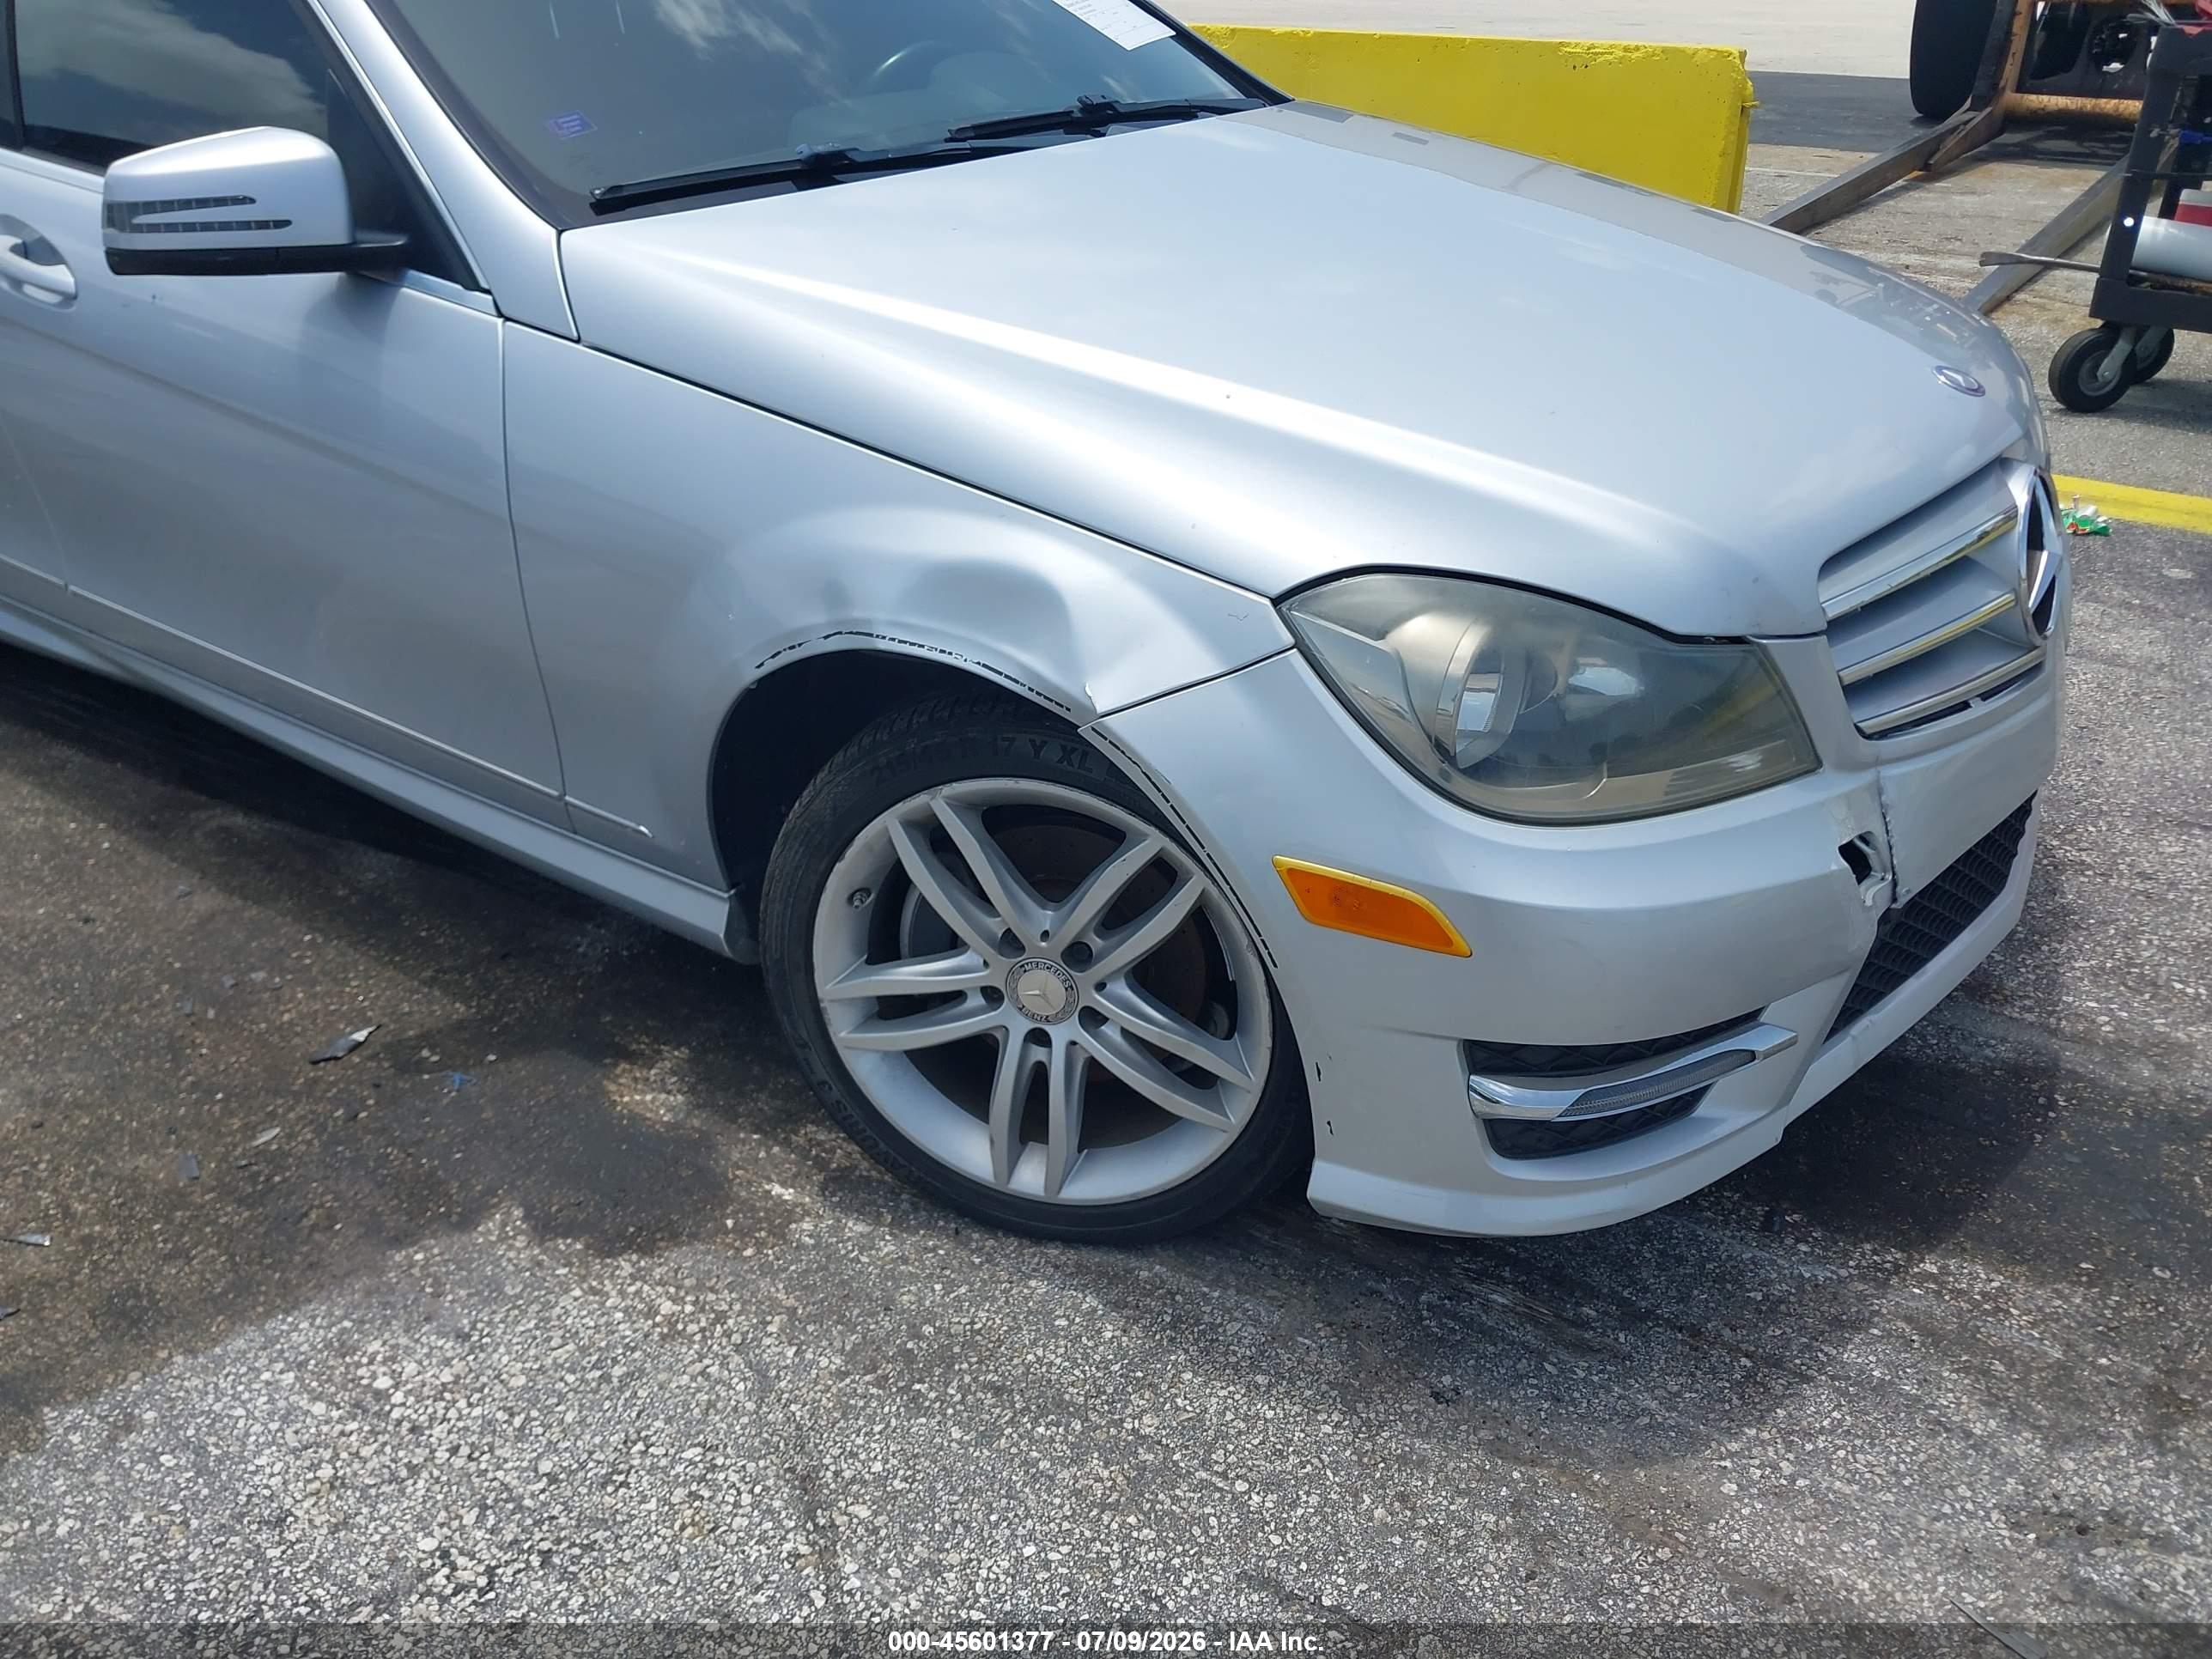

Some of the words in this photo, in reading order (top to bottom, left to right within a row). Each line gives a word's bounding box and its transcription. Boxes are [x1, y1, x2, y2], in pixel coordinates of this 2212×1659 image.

[989, 736, 1018, 757] 17
[1027, 738, 1047, 761] Y
[1055, 743, 1097, 774] XL
[1024, 962, 1071, 988] MERCEDES
[1021, 1007, 1047, 1022] BENZ
